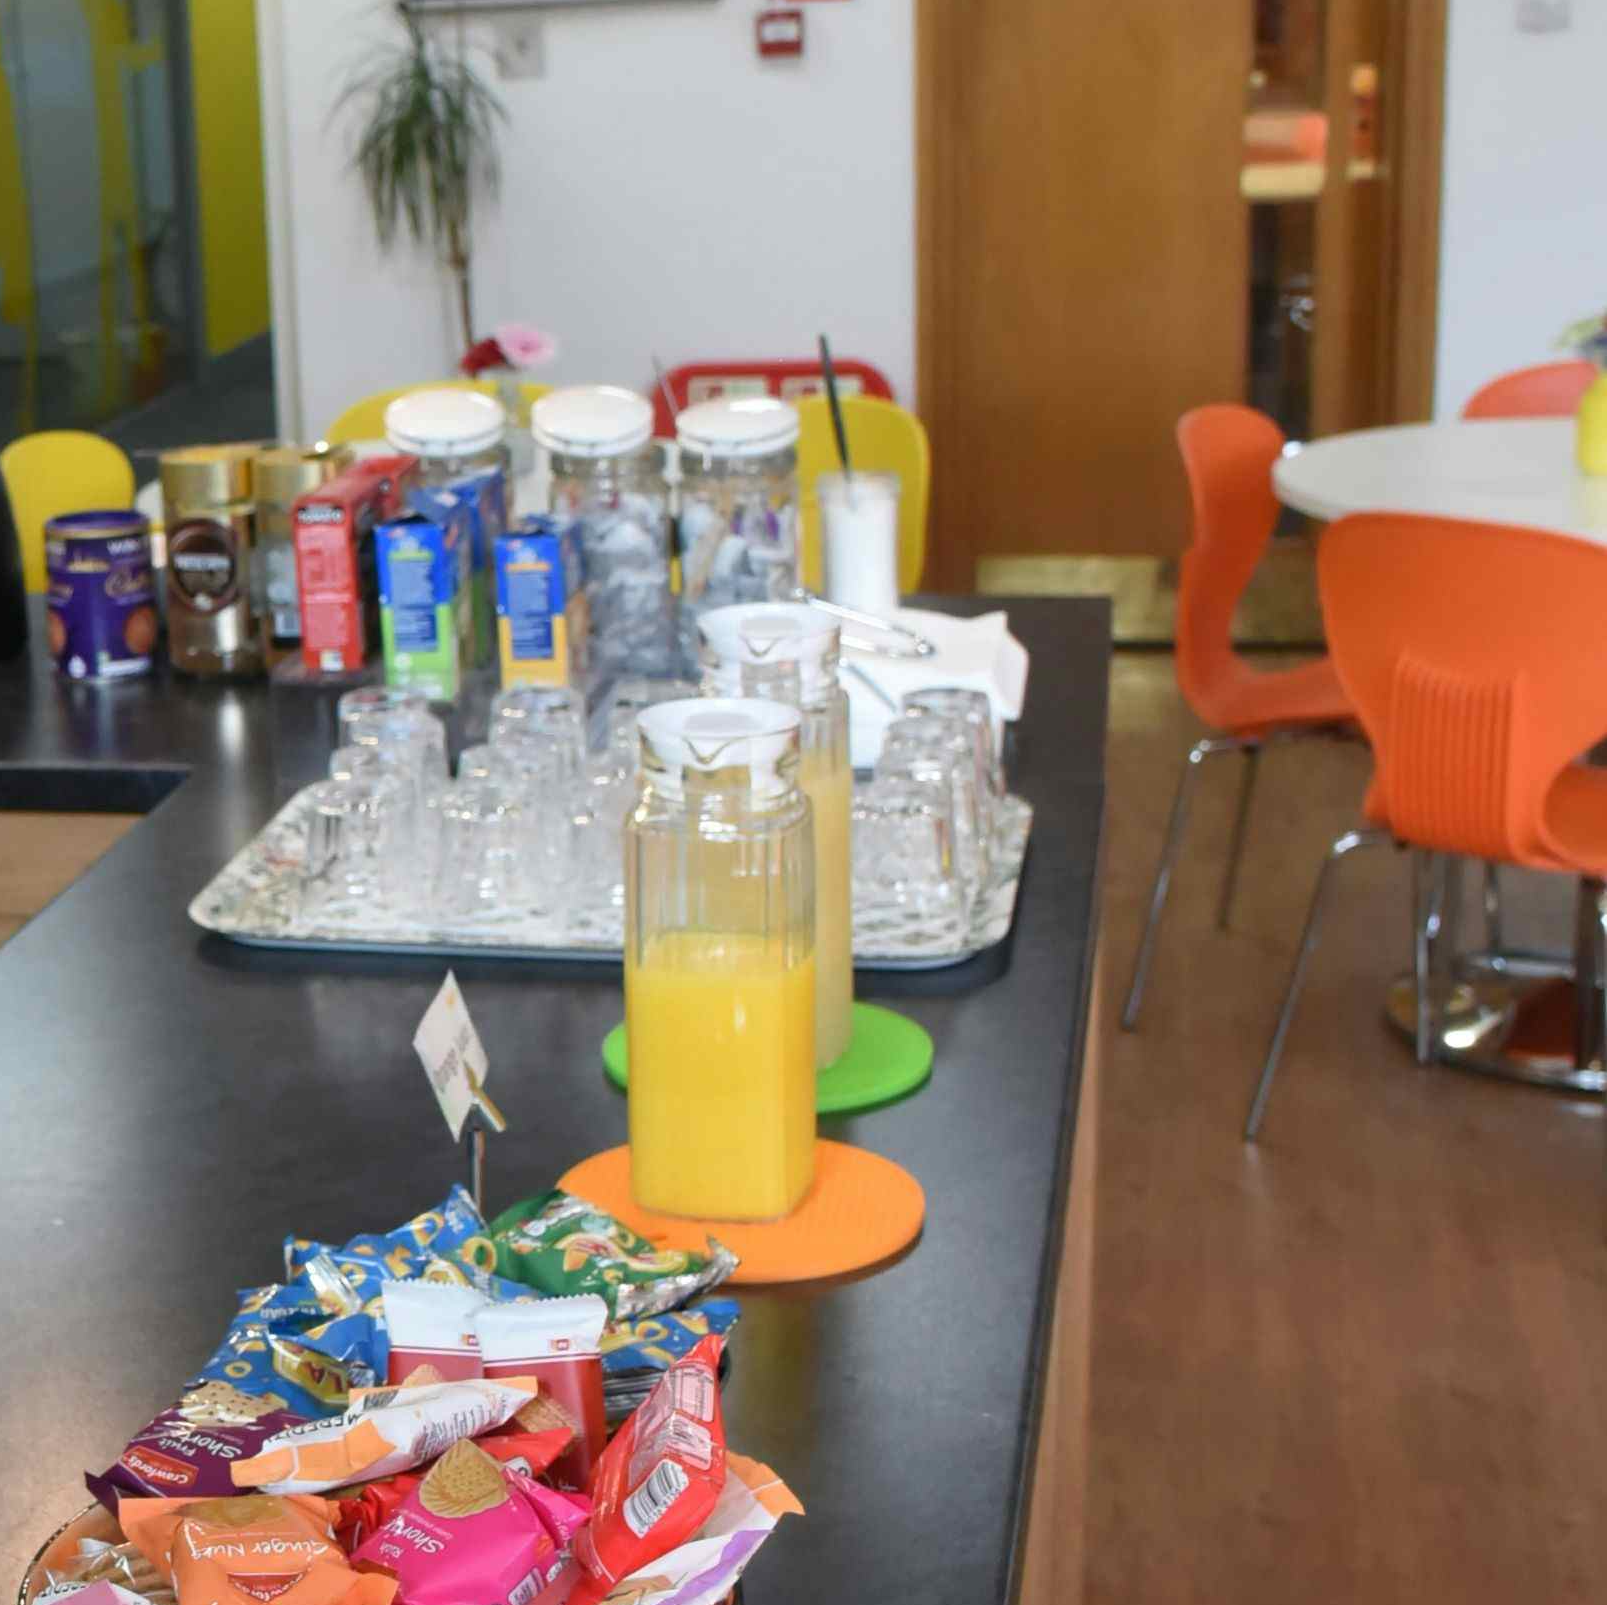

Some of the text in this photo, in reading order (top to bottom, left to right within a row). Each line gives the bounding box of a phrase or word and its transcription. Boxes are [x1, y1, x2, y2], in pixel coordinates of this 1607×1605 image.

[157, 1436, 197, 1458] Fruit
[127, 1454, 189, 1486] Crawford's
[252, 1538, 330, 1562] Ginger
